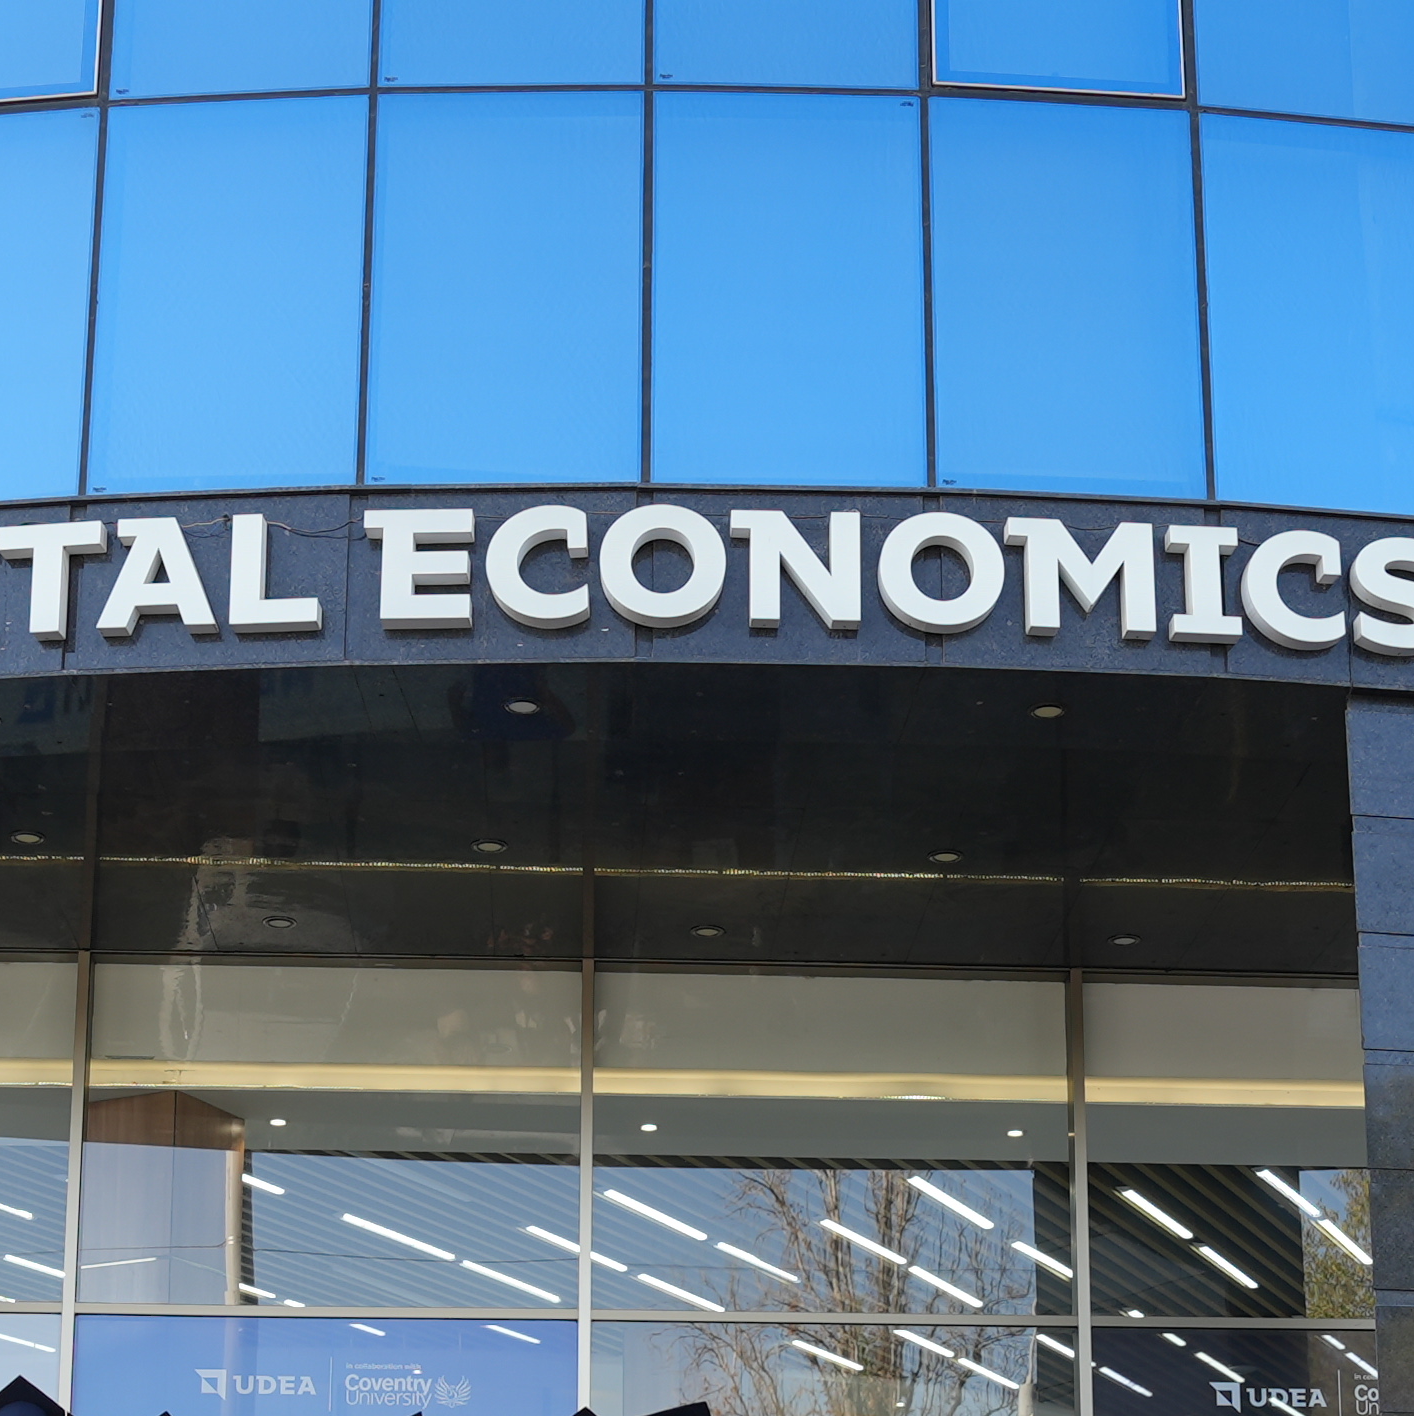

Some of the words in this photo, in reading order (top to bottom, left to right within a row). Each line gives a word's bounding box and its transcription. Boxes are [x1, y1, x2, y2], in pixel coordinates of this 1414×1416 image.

[233, 1375, 317, 1396] UDEA
[344, 1373, 433, 1393] Coventry
[346, 1389, 432, 1410] University
[1246, 1387, 1328, 1408] UDEA
